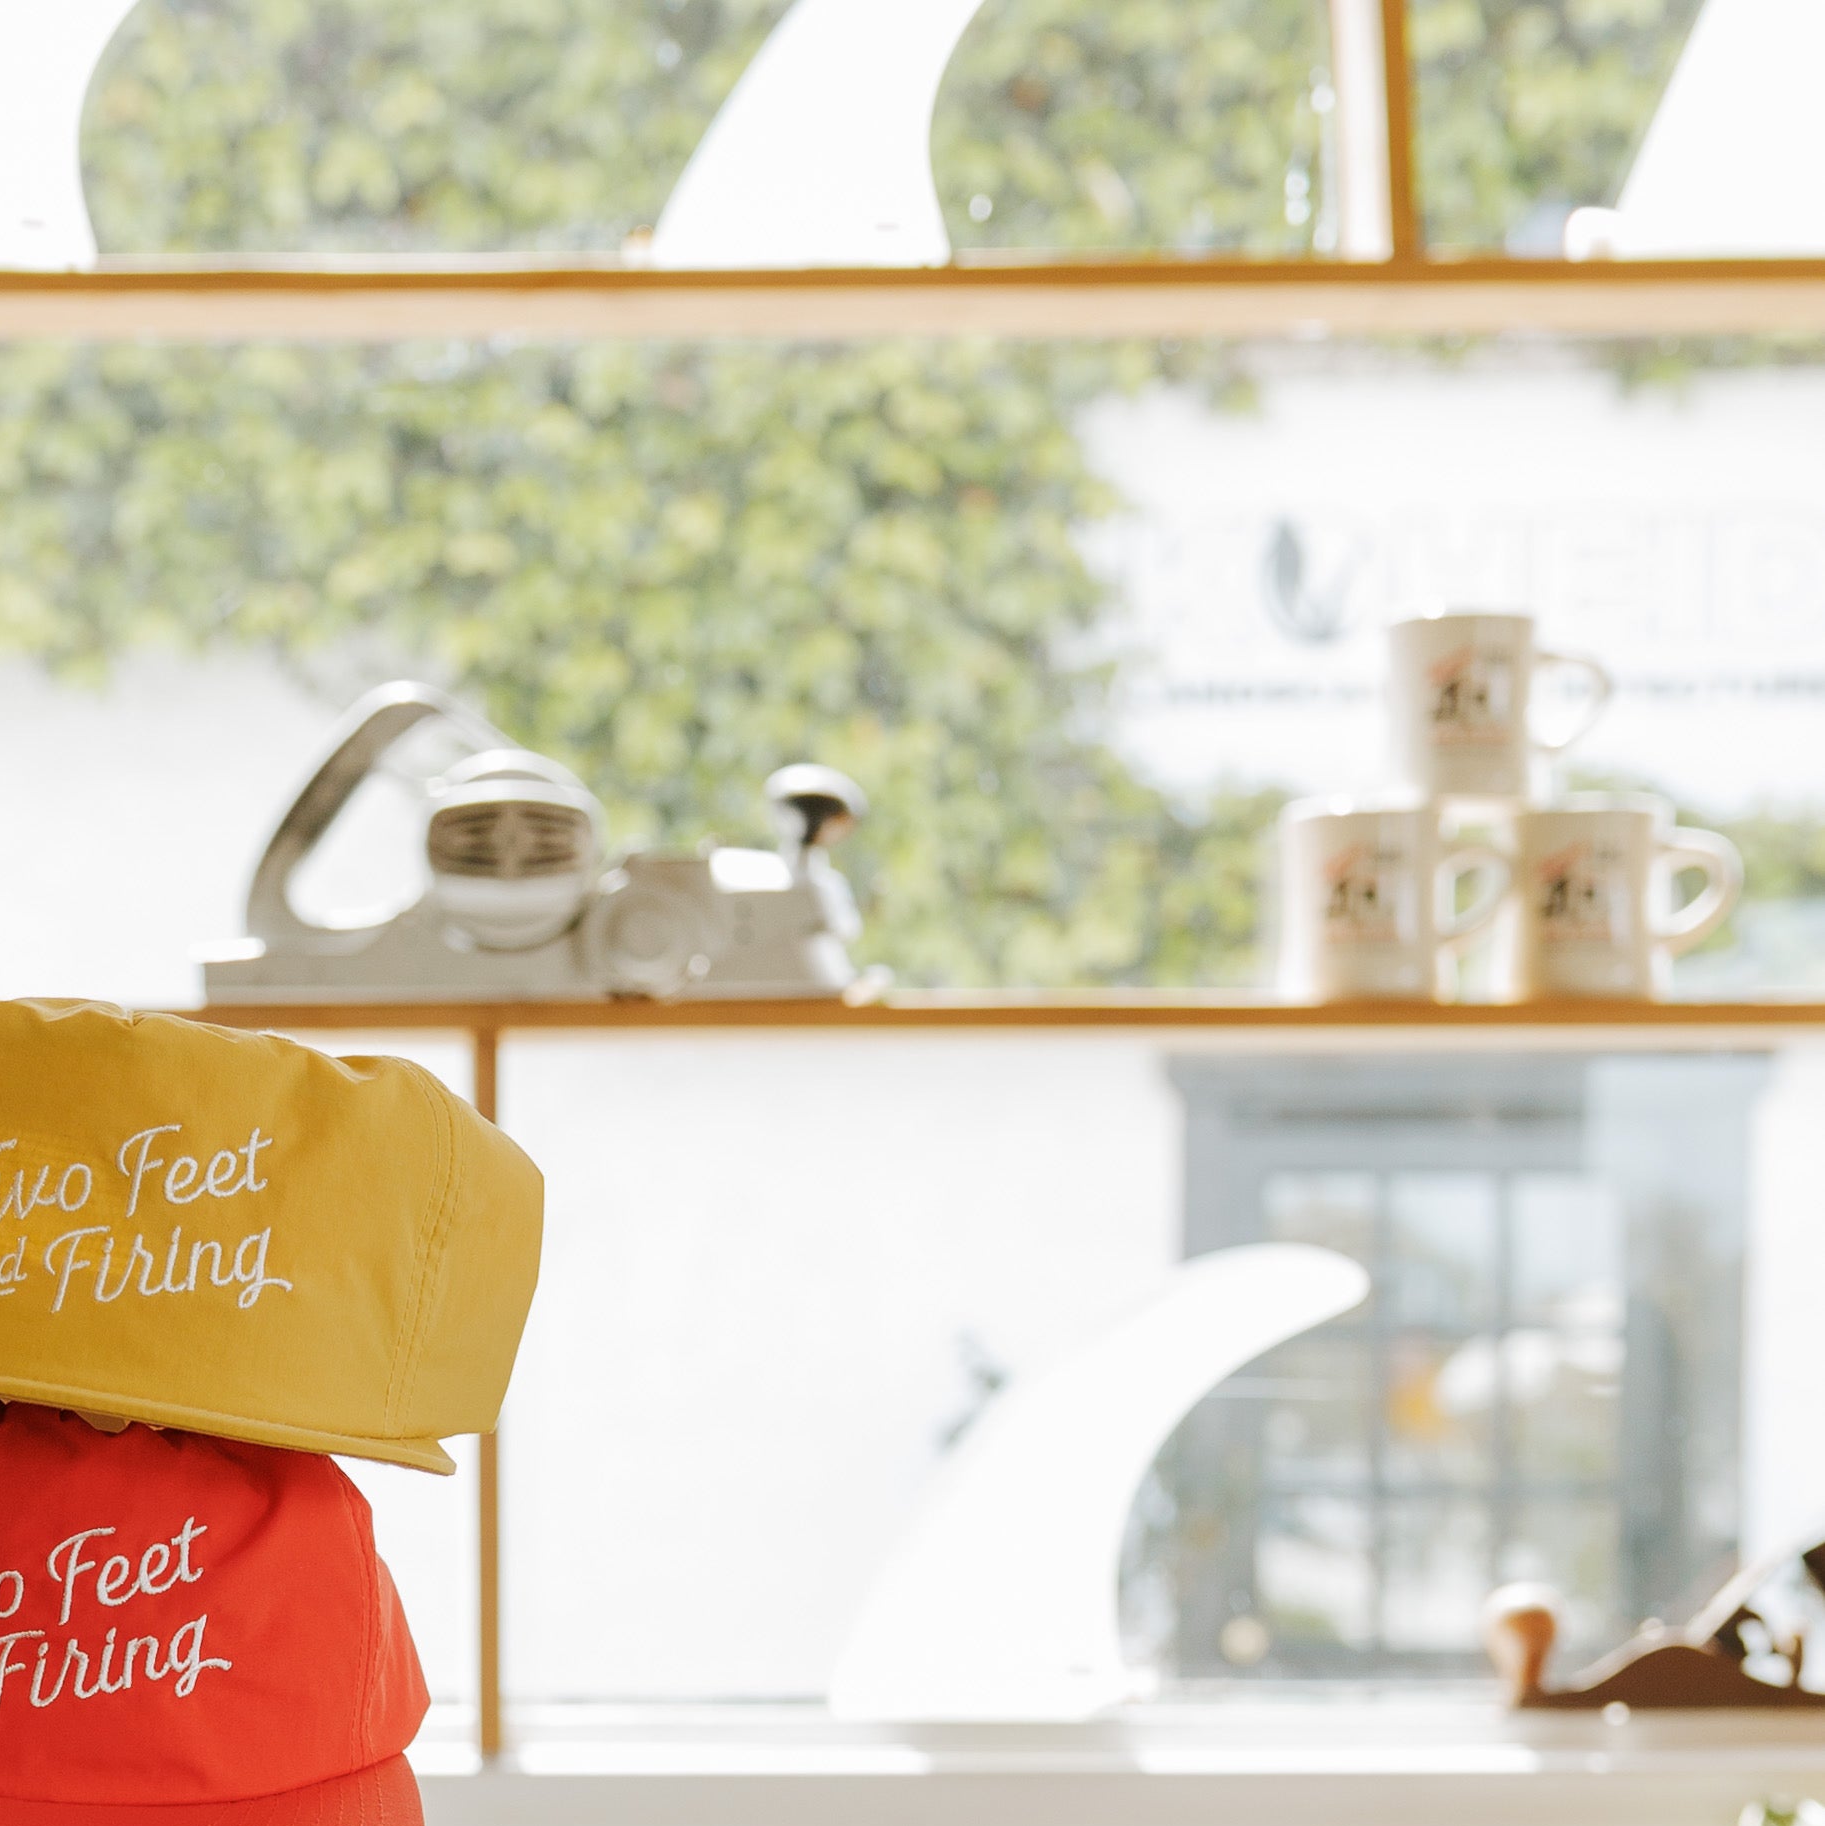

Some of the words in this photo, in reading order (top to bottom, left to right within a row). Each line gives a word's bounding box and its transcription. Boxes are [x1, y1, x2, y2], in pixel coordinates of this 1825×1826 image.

[117, 1124, 272, 1217] Feet
[44, 1225, 294, 1313] Firing
[46, 1516, 208, 1626] Feet
